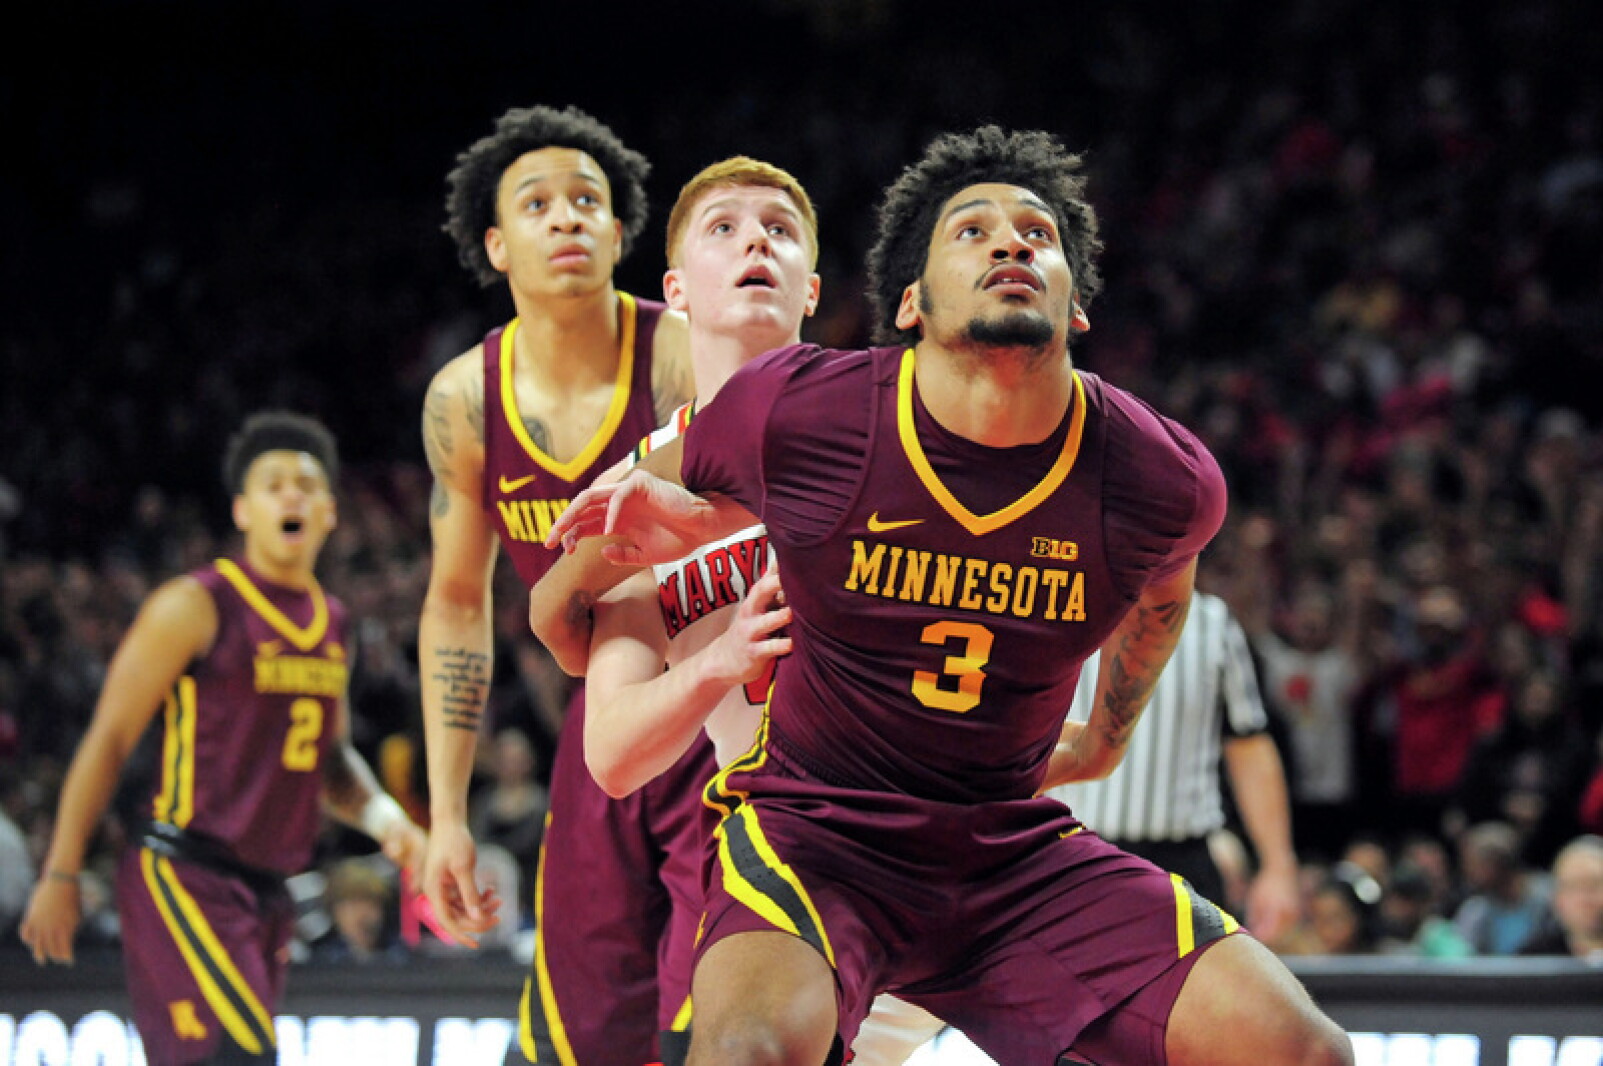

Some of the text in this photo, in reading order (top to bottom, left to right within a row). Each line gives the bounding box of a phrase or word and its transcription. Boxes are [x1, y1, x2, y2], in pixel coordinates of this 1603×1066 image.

[844, 540, 1087, 622] MINNESOTA
[911, 620, 995, 714] 3
[281, 697, 324, 772] 2
